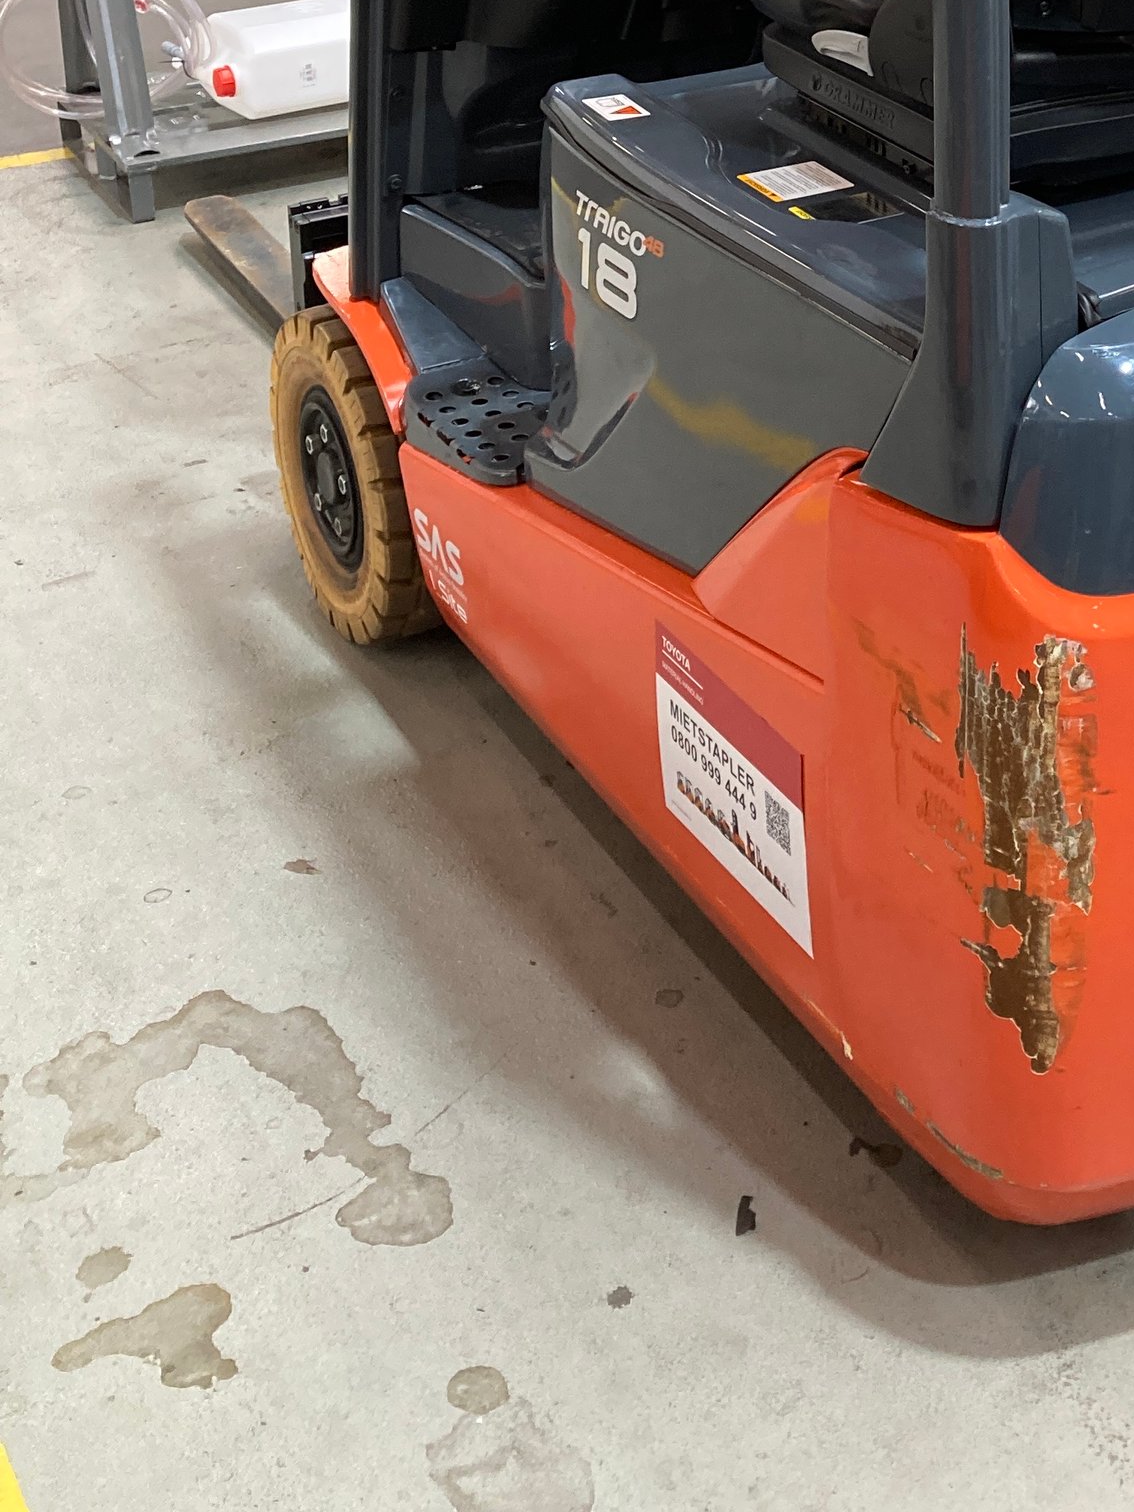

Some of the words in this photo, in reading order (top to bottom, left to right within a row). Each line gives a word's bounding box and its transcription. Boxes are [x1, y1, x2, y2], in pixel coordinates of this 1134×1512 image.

[825, 82, 897, 130] GRAMMER
[578, 227, 638, 320] 18
[661, 635, 691, 672] TOYOTA
[669, 699, 756, 797] MIETSTAPLER
[671, 725, 698, 762] 0800
[701, 754, 721, 786] 999
[725, 780, 746, 811] 444
[749, 802, 757, 821] 9
